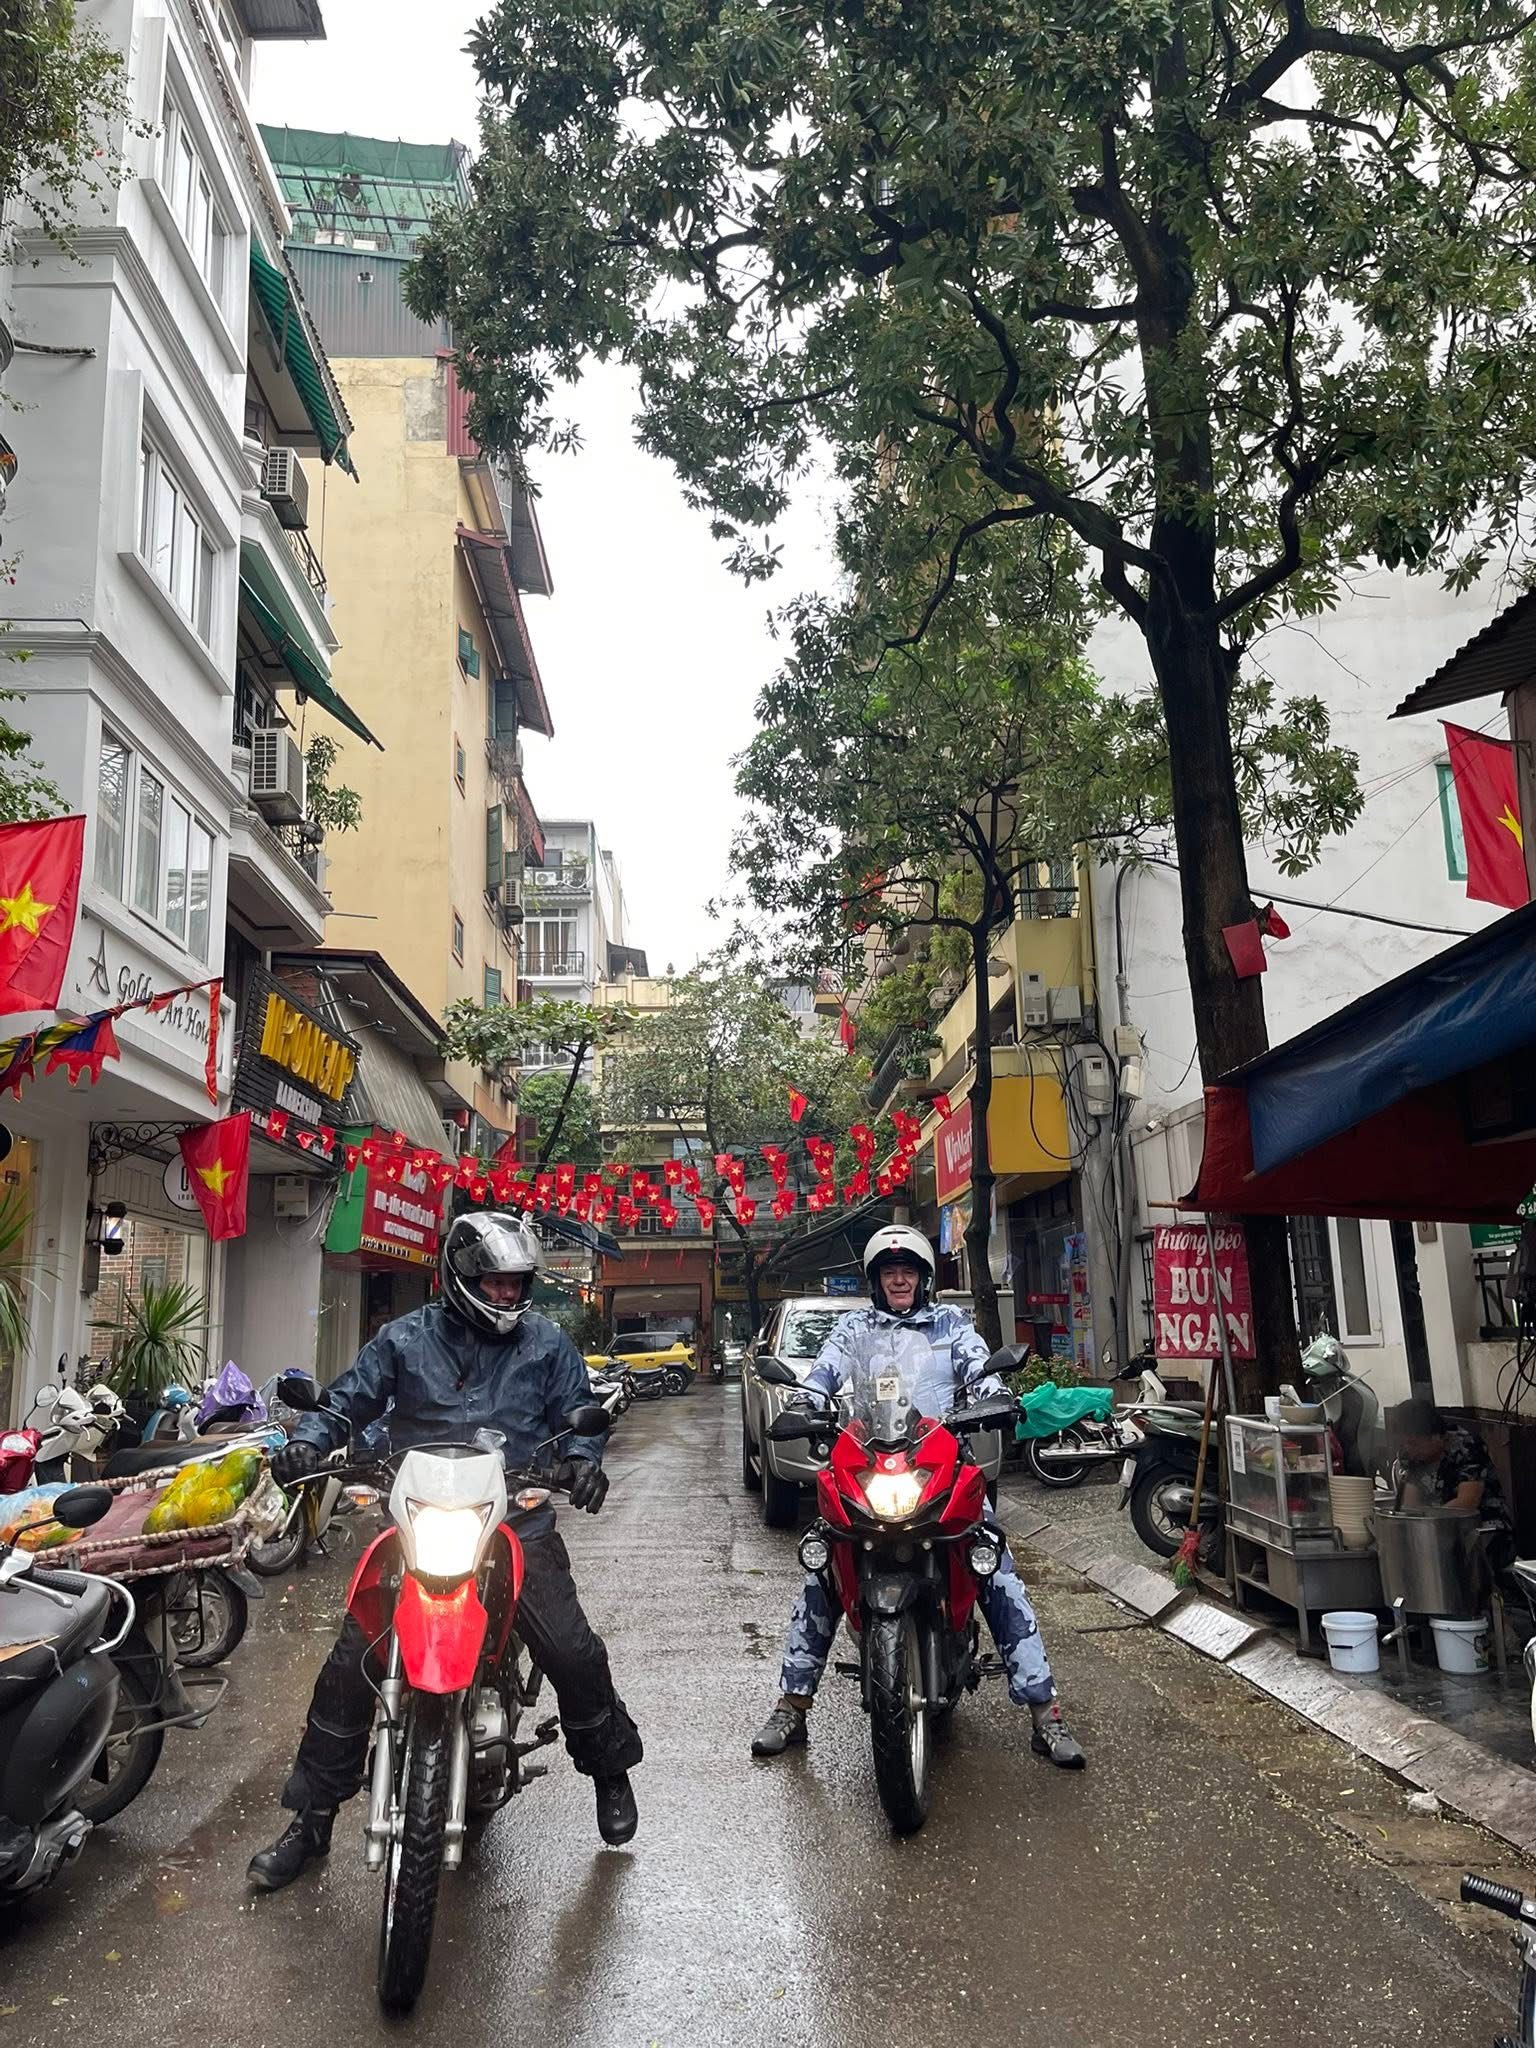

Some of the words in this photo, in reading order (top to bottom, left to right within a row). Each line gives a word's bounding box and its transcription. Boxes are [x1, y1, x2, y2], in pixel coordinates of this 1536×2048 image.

[160, 1000, 184, 1029] Art
[184, 1007, 210, 1045] Hote
[1157, 1229, 1209, 1256] Hương
[1157, 1312, 1250, 1353] NGAN
